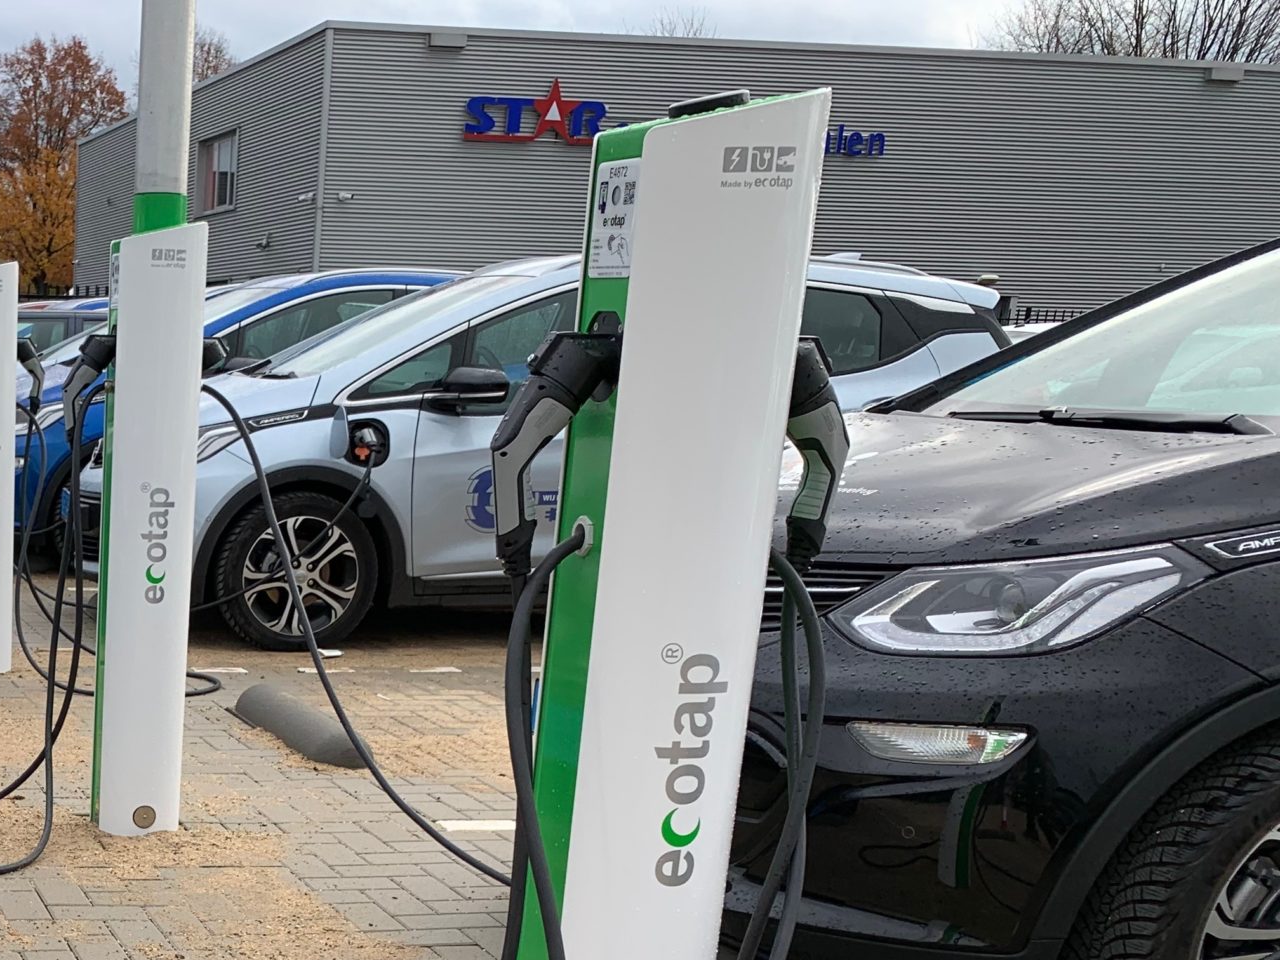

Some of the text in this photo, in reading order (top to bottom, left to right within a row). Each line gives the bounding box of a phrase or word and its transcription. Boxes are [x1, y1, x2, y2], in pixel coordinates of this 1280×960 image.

[464, 77, 607, 143] STAR
[743, 180, 753, 189] by
[754, 175, 793, 189] ecotap
